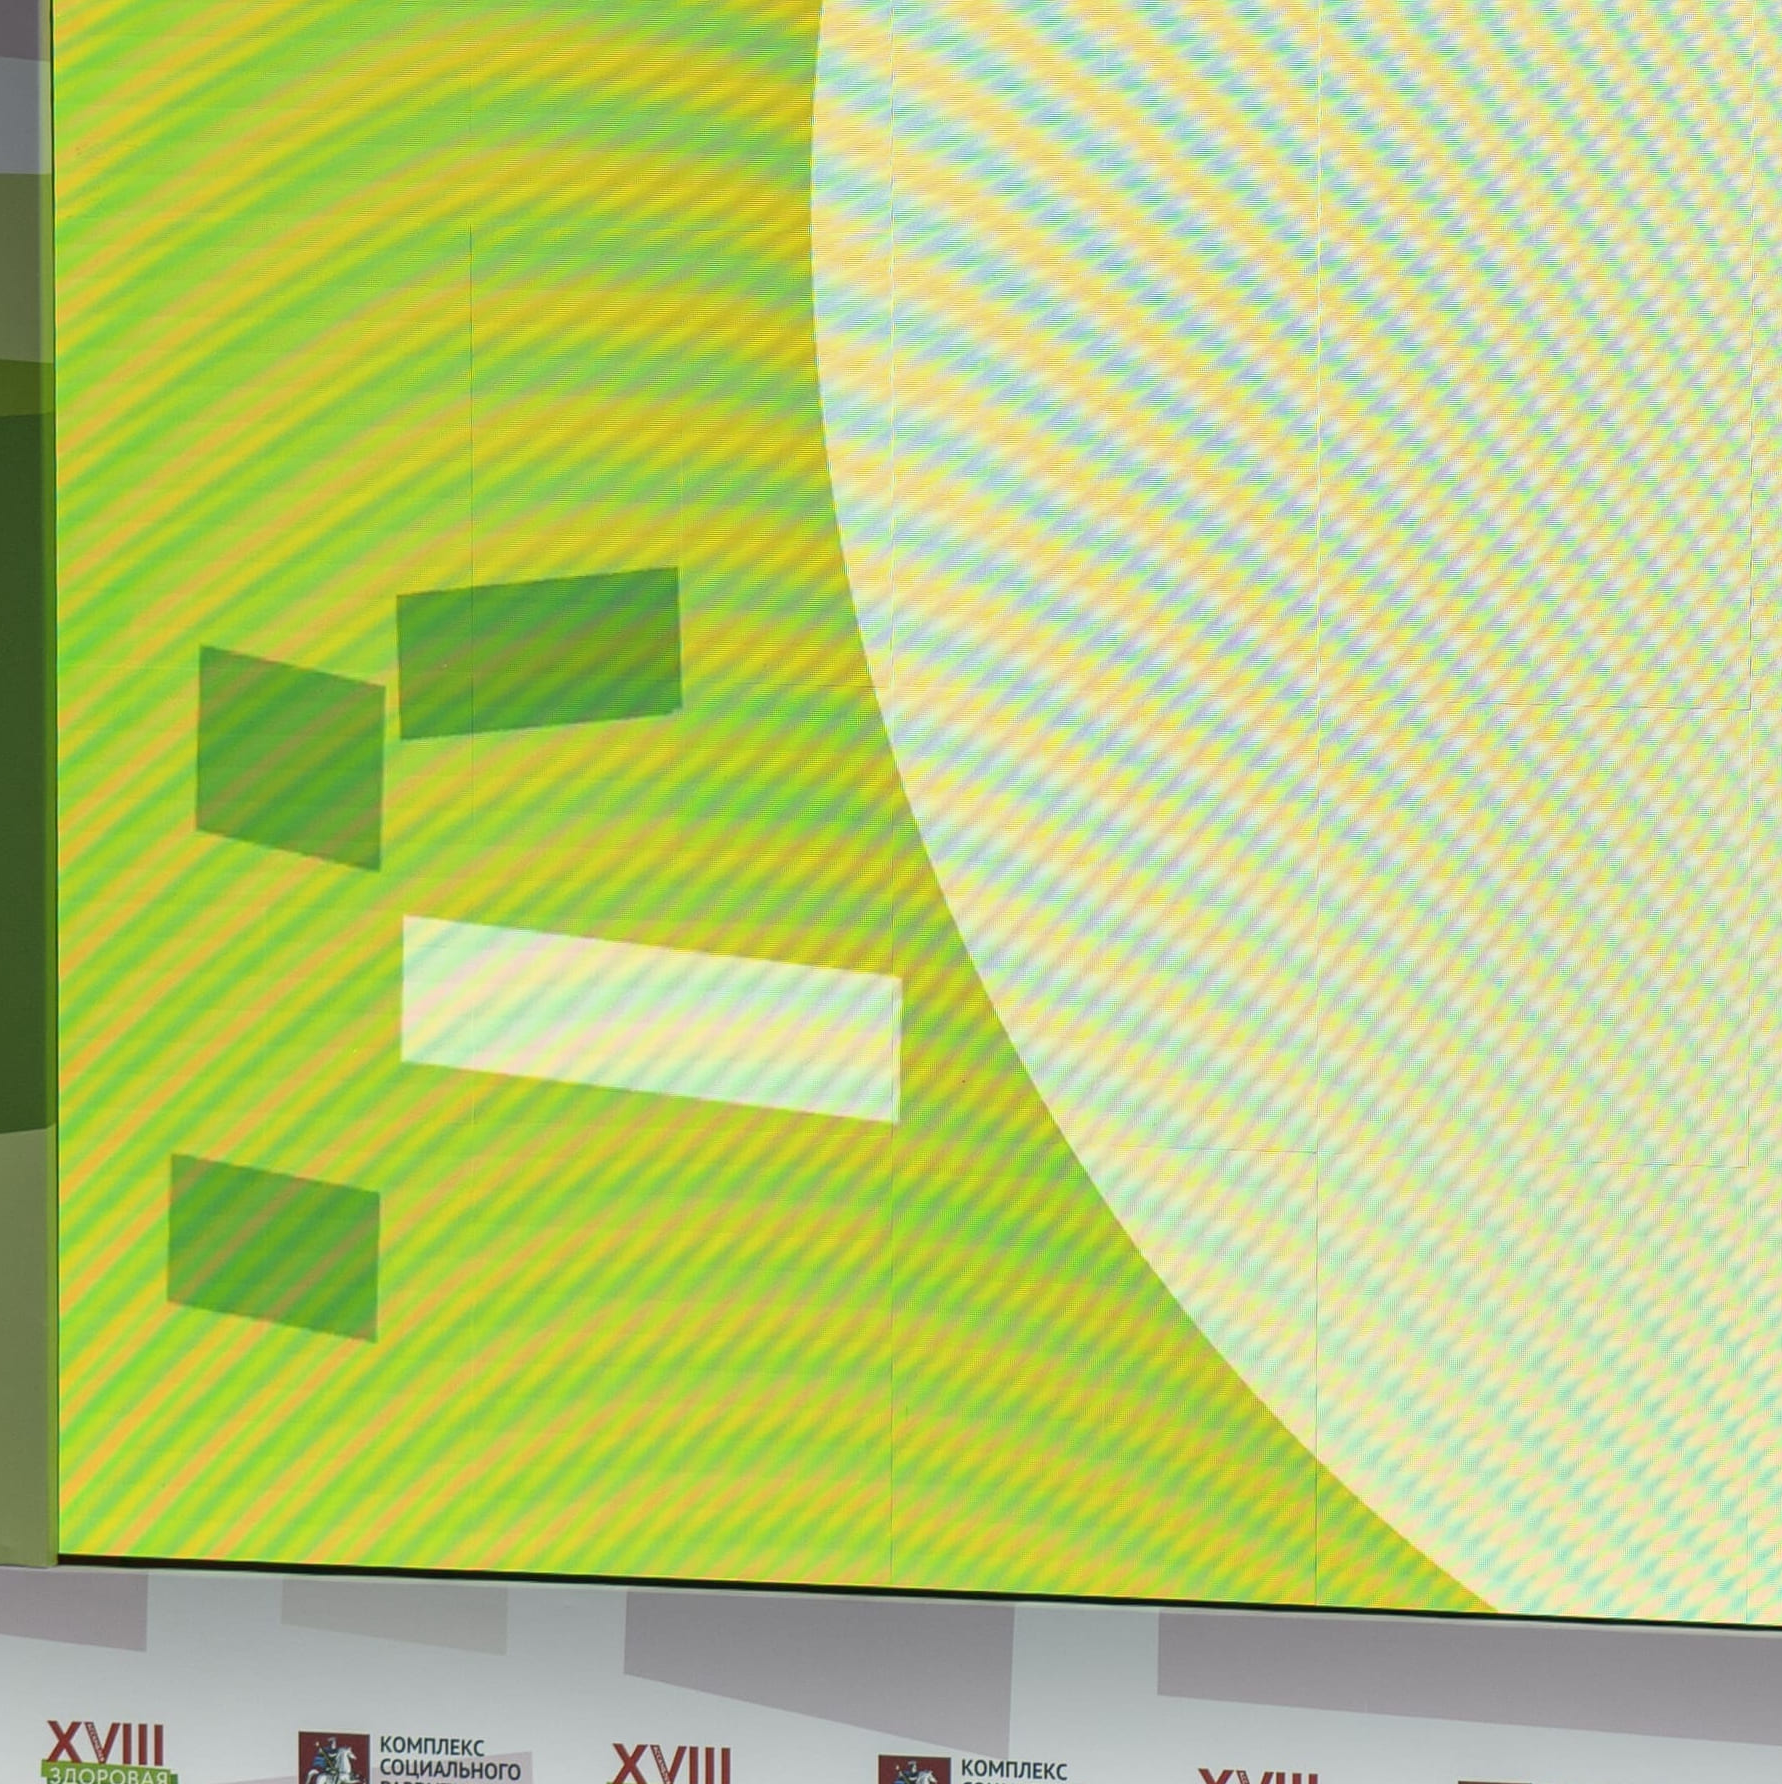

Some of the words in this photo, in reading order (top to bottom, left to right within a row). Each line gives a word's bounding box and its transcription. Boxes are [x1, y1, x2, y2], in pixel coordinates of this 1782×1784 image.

[48, 1721, 162, 1766] XVIII
[380, 1735, 485, 1758] КОМПЛЕКС
[379, 1757, 522, 1782] СОЦИАЛЬНОГО
